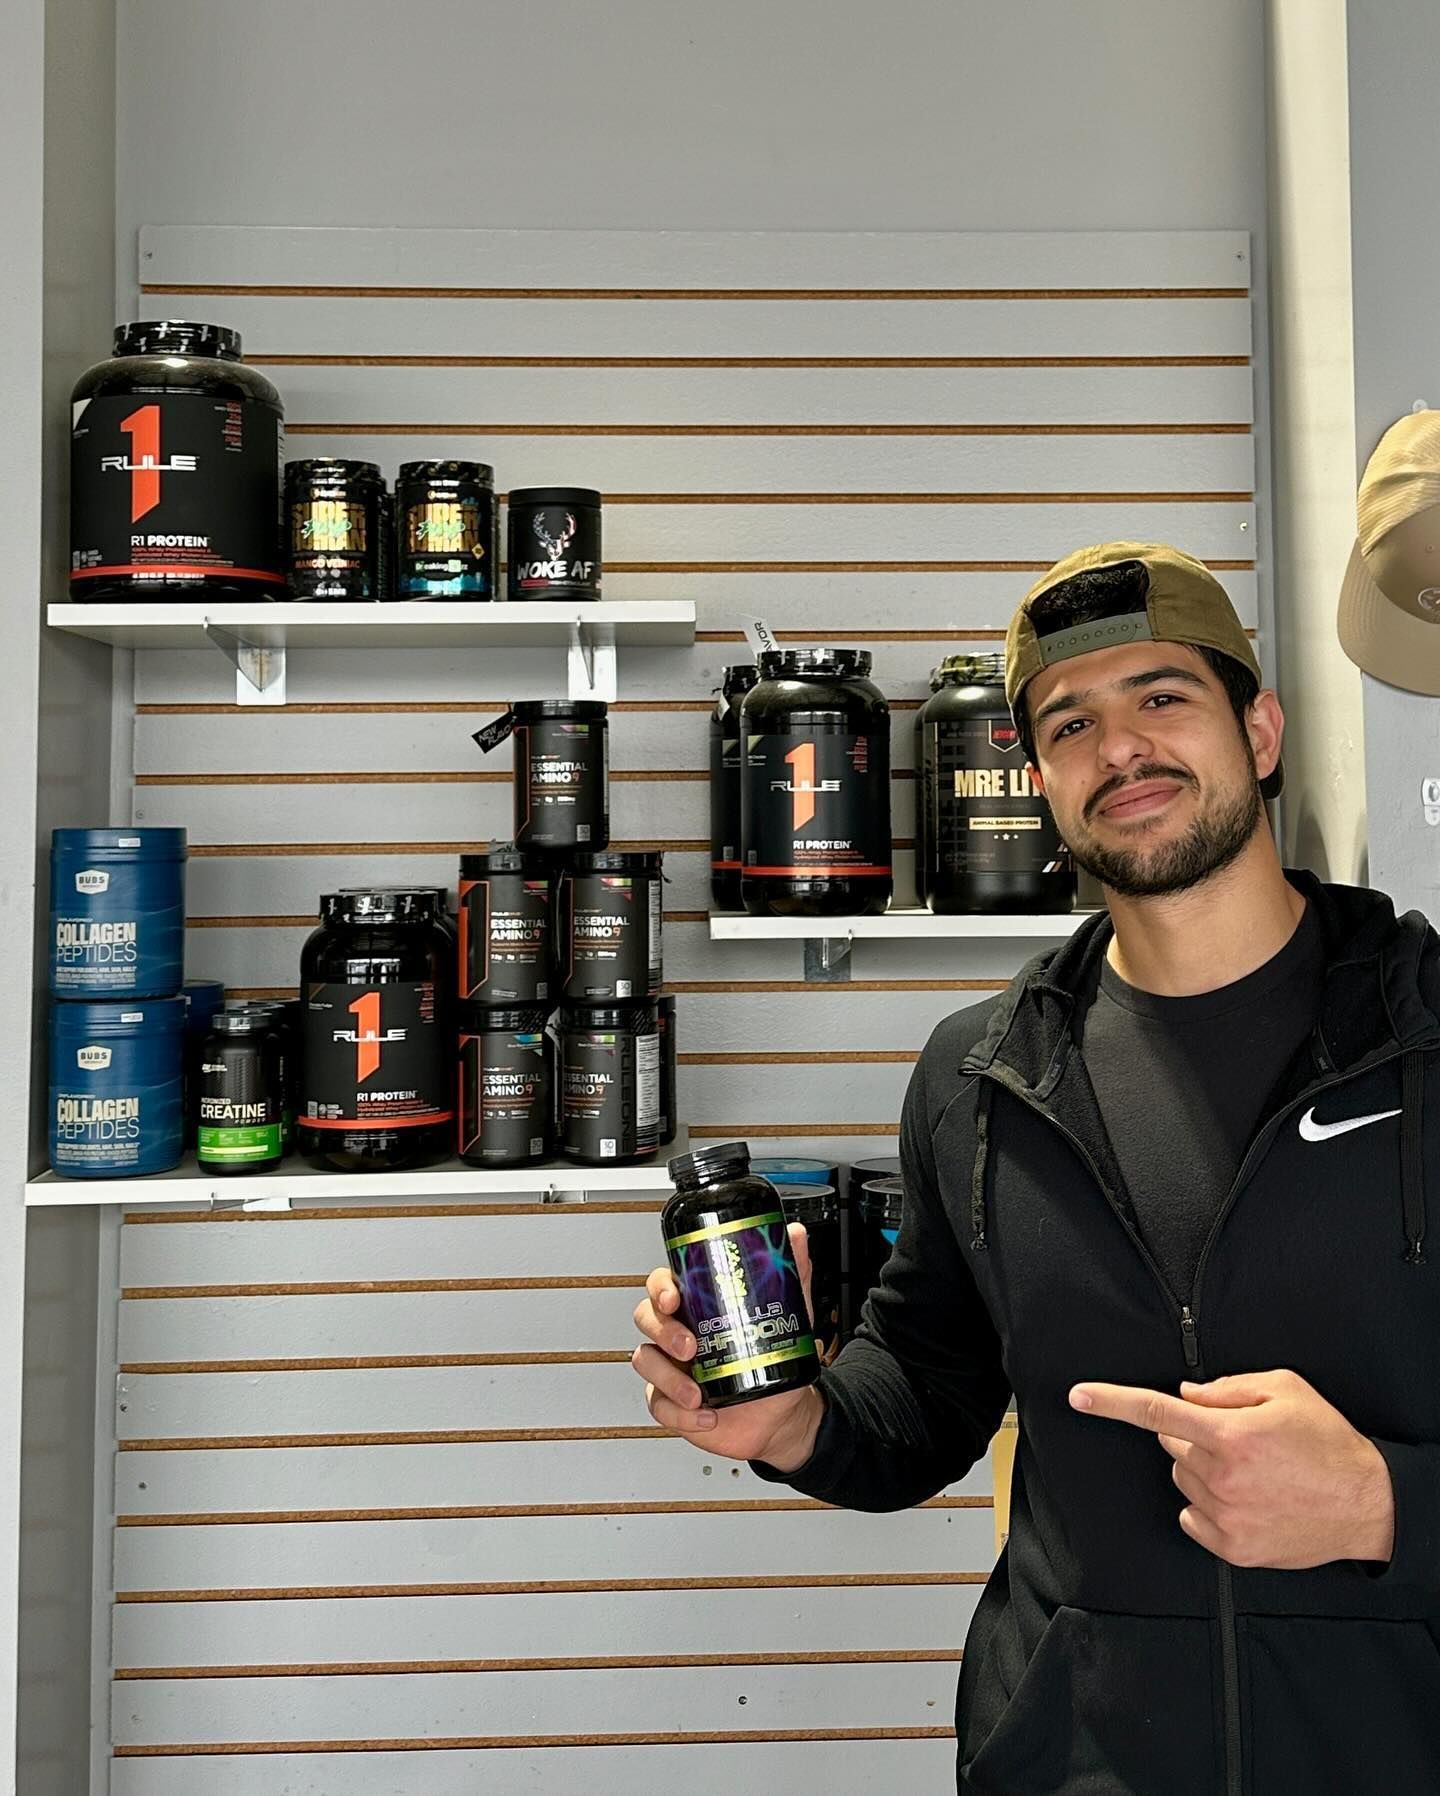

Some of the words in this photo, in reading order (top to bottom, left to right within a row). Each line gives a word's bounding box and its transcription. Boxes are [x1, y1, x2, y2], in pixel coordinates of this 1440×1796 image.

[101, 454, 196, 472] RULE
[131, 535, 145, 547] R1
[147, 535, 208, 547] PROTEIN
[516, 560, 568, 580] WOKE
[571, 560, 594, 580] AF
[487, 724, 511, 747] FLAVO
[531, 762, 588, 772] ESSENTIAL
[531, 773, 571, 783] AMINO
[954, 768, 1005, 797] MRE
[770, 780, 841, 791] RULE
[793, 840, 804, 849] R1
[805, 840, 850, 849] PROTEIN
[79, 876, 105, 884] BUBS
[491, 919, 547, 929] ESSENTIAL
[574, 916, 630, 926] ESSENTIAL
[56, 922, 136, 947] COLLAGEN
[491, 929, 532, 940] AMINO
[575, 926, 612, 937] AMINO
[56, 941, 137, 963] PEPTIDES
[333, 1029, 405, 1042] RULE
[80, 1052, 107, 1060] BUBS
[483, 1073, 541, 1084] ESSENTIAL
[565, 1073, 614, 1083] SSENTIAL
[357, 1092, 368, 1101] R1
[370, 1090, 416, 1101] PROTEIN
[483, 1085, 524, 1096] AMINO
[57, 1097, 139, 1122] COLLAGEN
[201, 1103, 266, 1119] CREATINE
[57, 1117, 139, 1139] PEPTIDES
